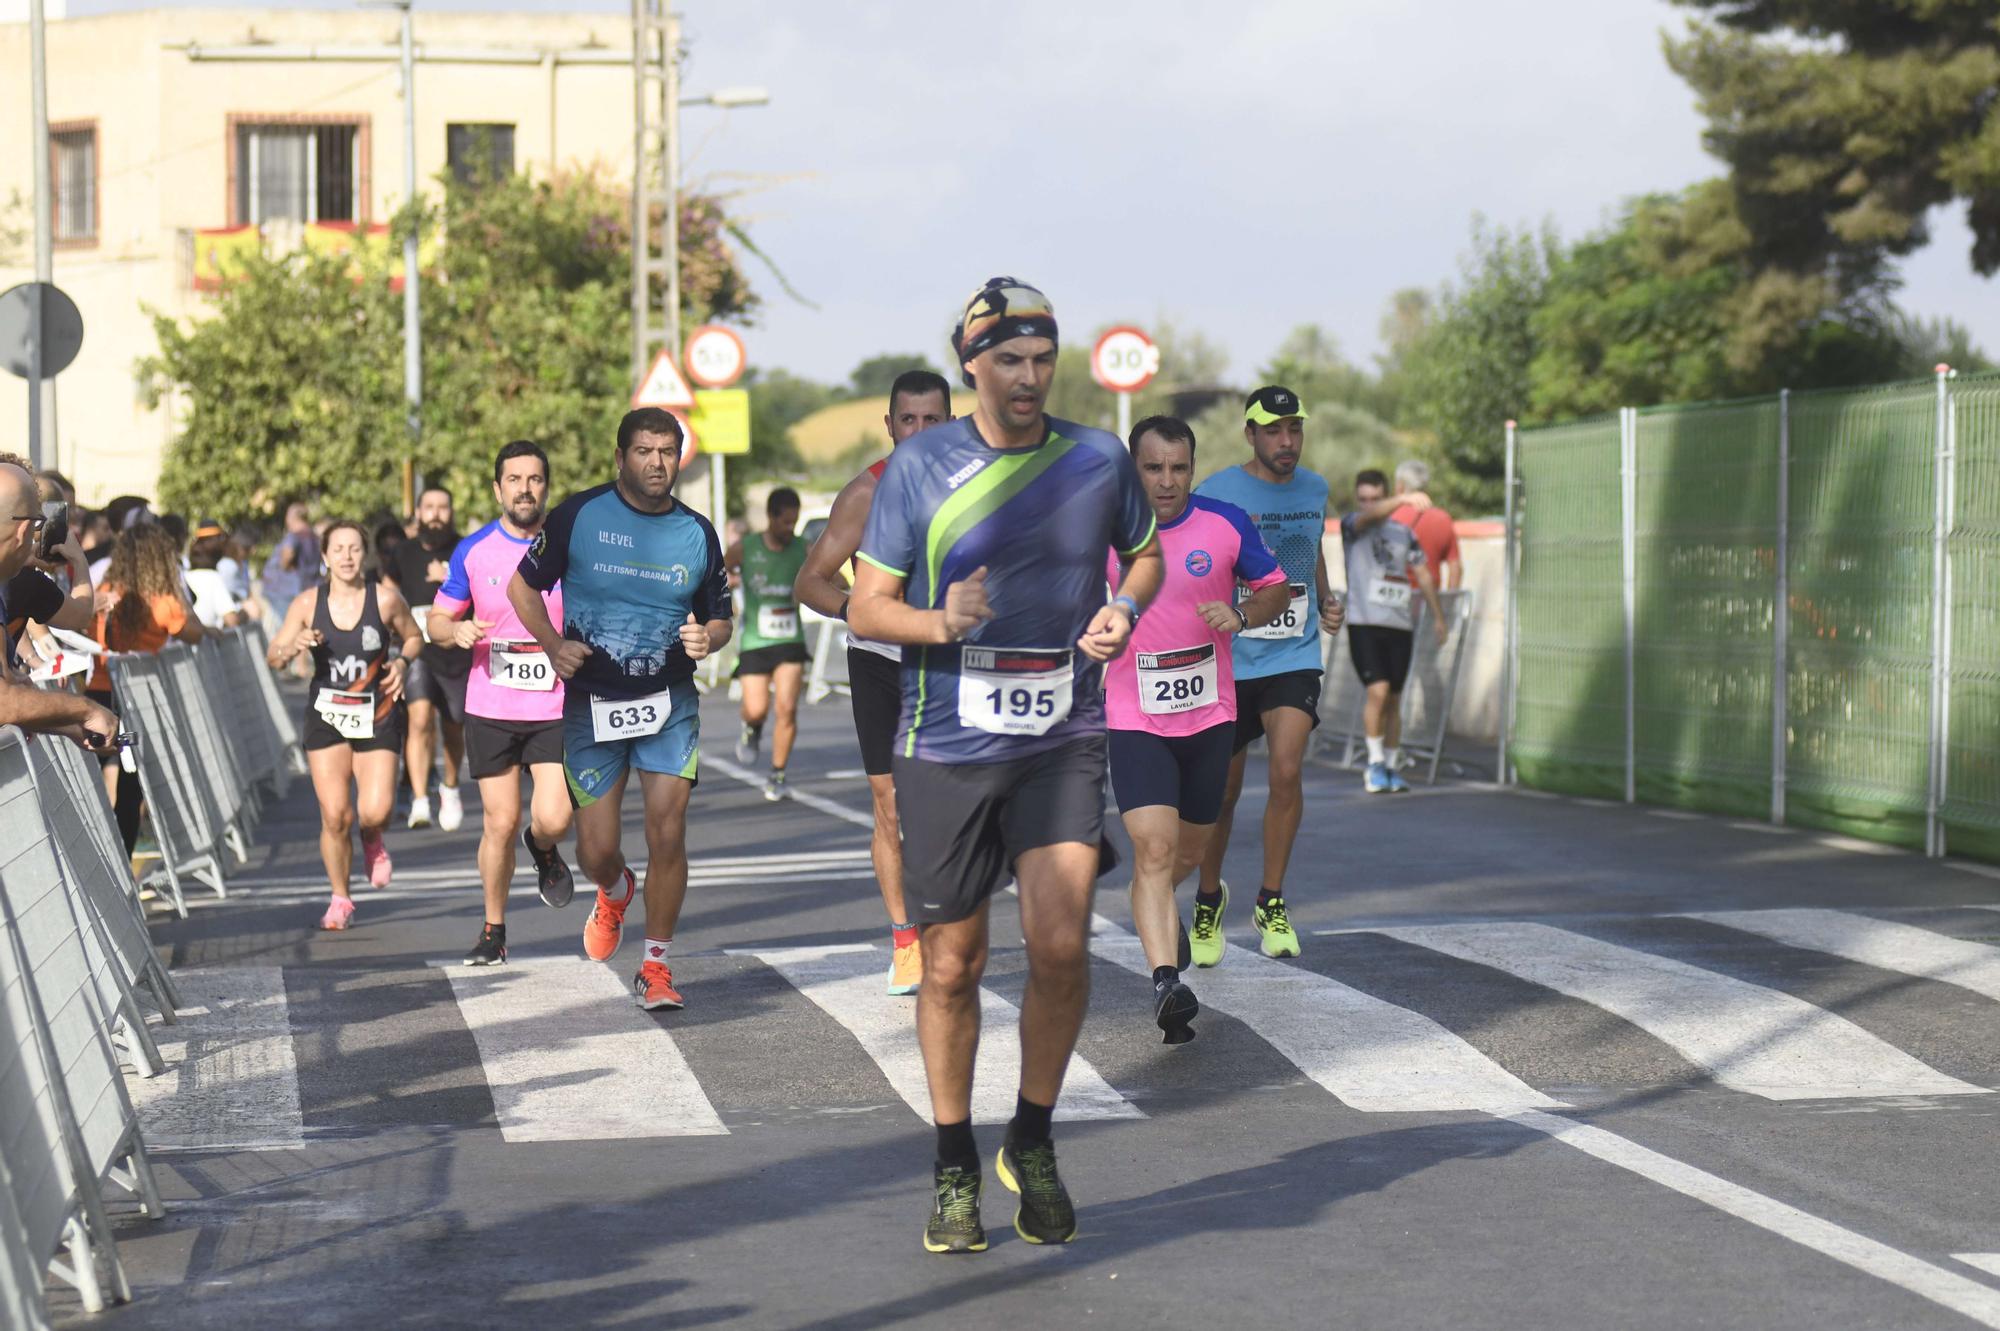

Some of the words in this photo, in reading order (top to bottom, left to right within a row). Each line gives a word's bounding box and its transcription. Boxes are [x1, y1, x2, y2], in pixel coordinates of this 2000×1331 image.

[1108, 350, 1142, 369] 30
[599, 530, 634, 548] ULEVEL
[593, 562, 638, 577] ATLETISMO
[639, 569, 671, 583] ABARÁN
[503, 663, 546, 679] 180
[1155, 675, 1204, 701] 280
[986, 688, 1055, 717] 195
[1170, 701, 1194, 710] LAVELA
[608, 705, 657, 728] 633
